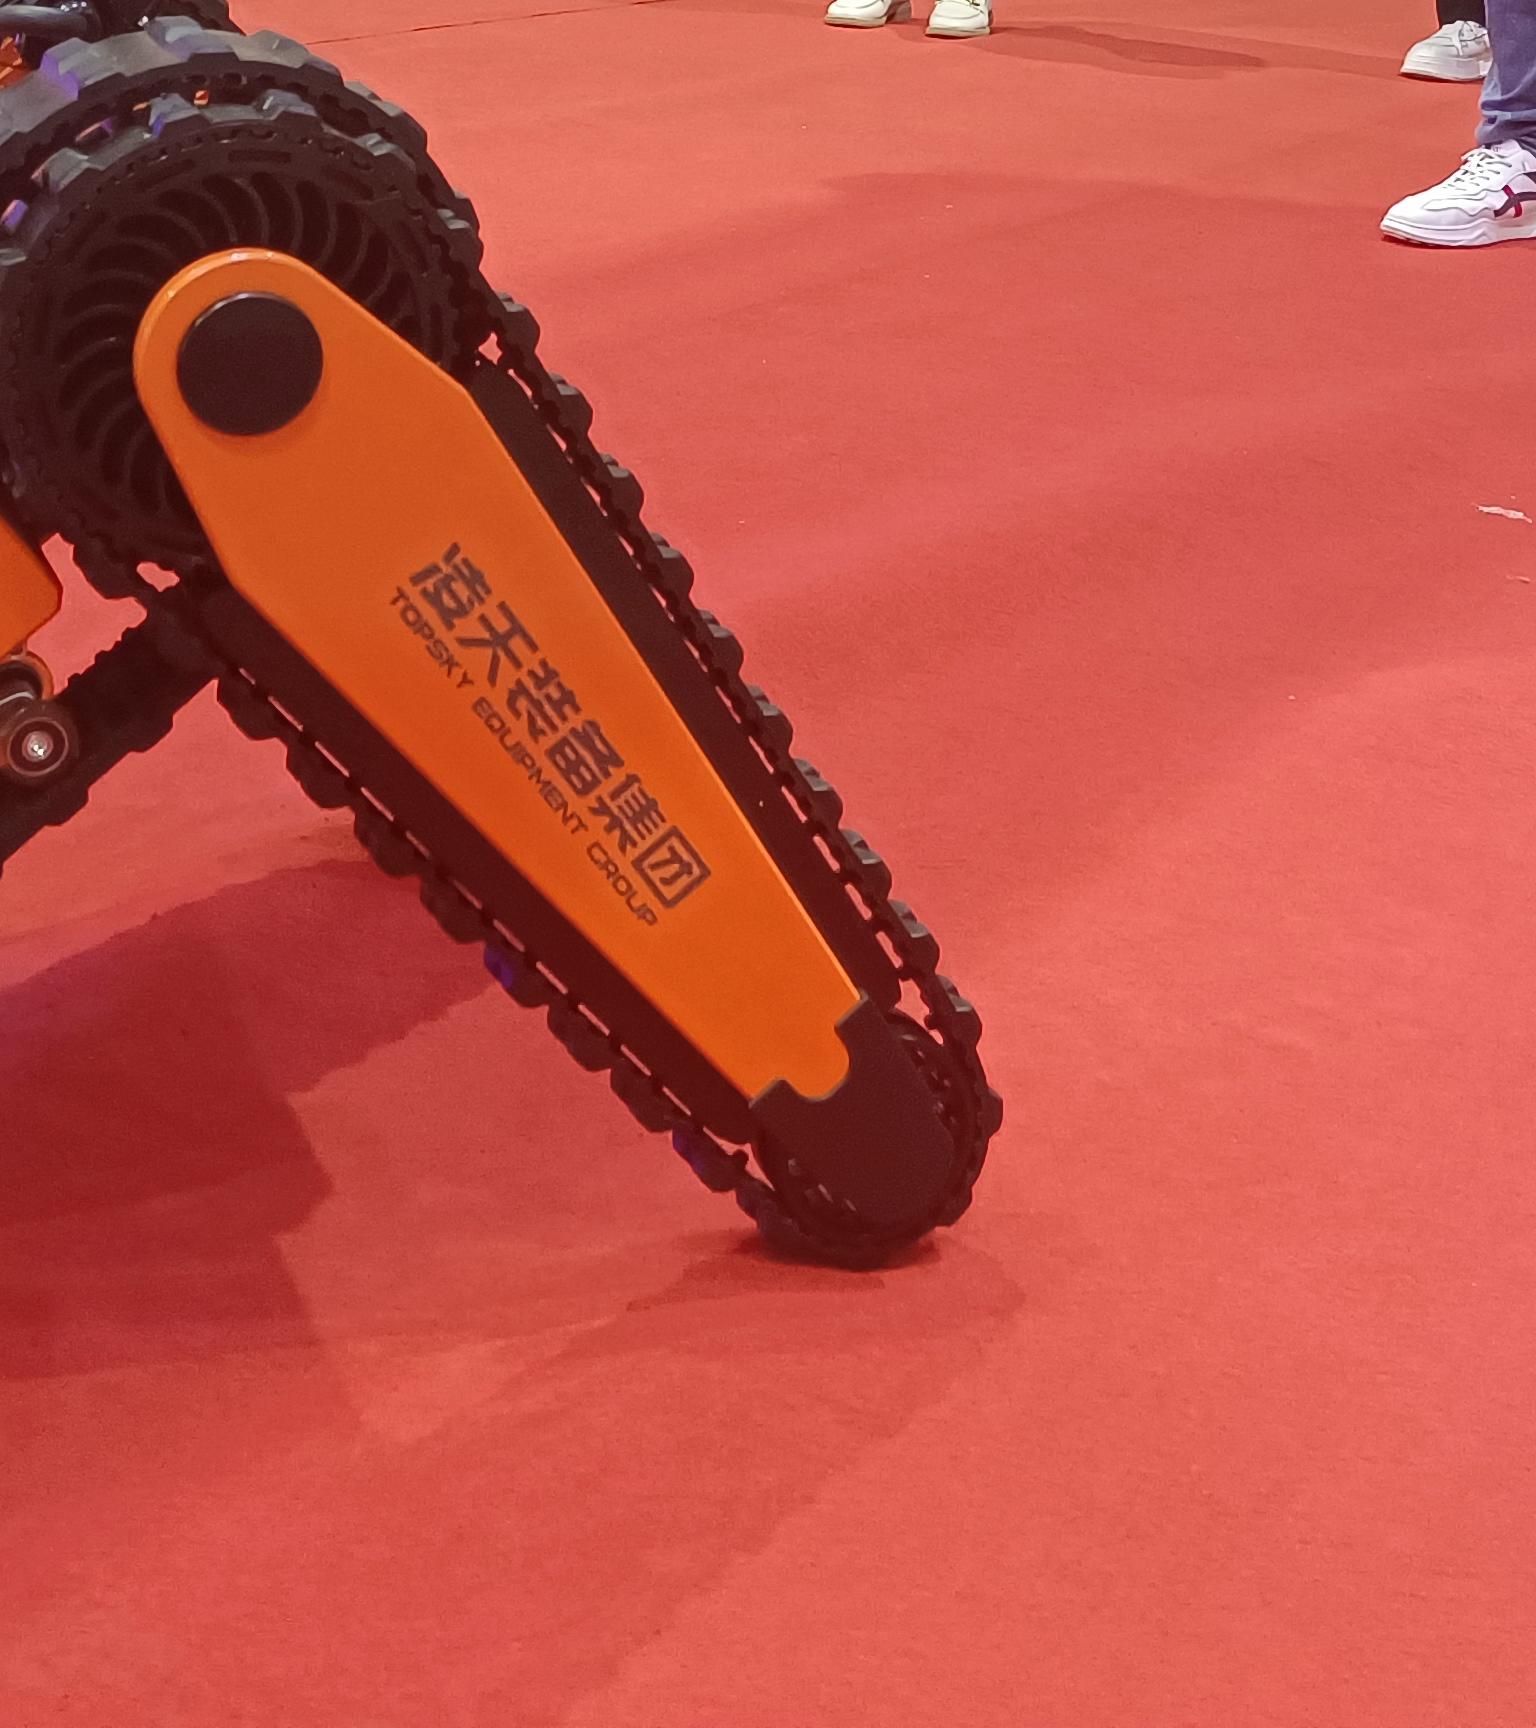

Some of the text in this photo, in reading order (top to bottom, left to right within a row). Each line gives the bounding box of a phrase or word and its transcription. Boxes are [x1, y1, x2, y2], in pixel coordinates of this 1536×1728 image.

[389, 586, 659, 926] TOPSKY EQUIPMENT GROUP
[408, 542, 712, 909] 凌天装备集团
